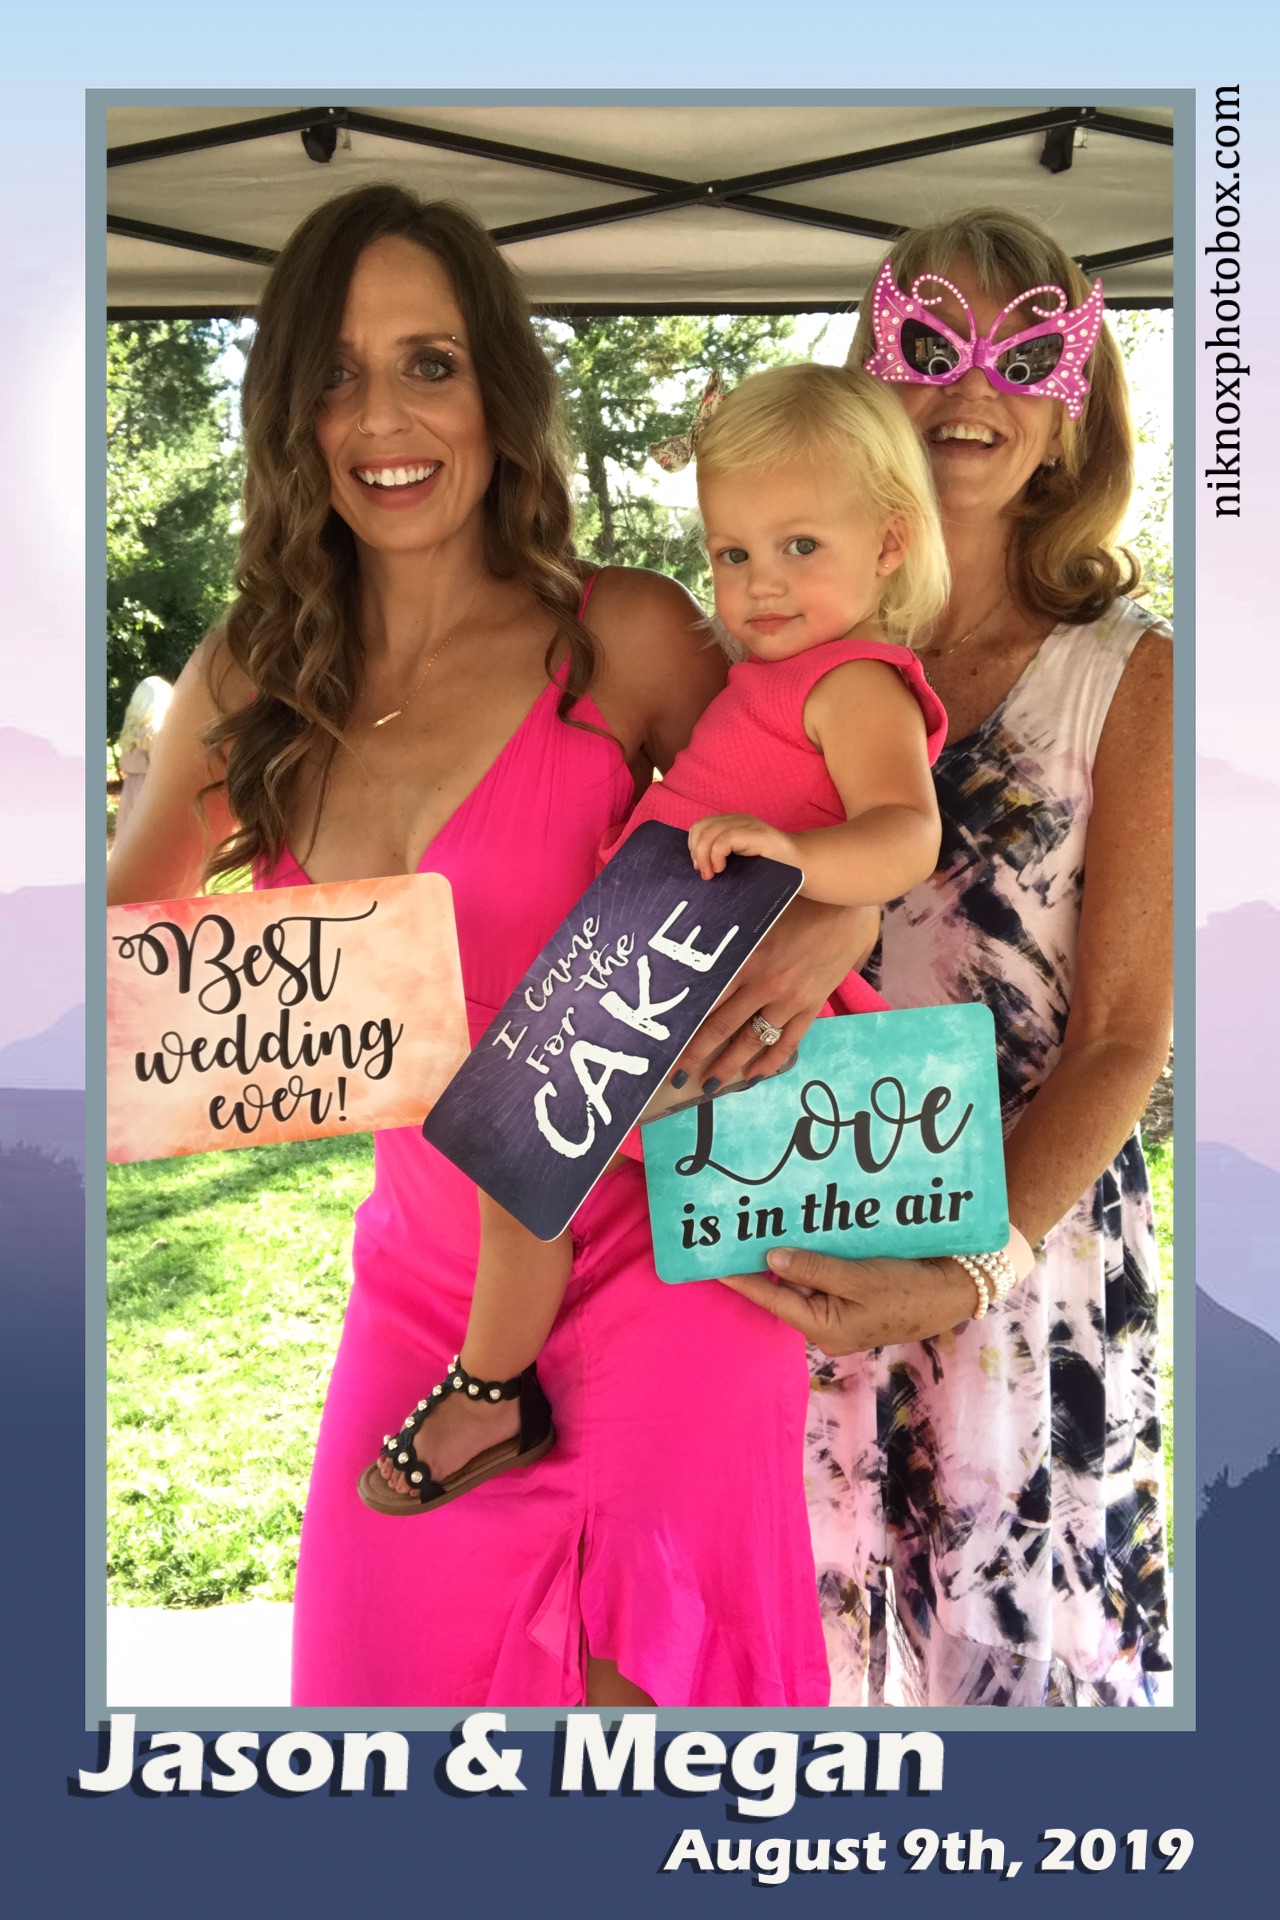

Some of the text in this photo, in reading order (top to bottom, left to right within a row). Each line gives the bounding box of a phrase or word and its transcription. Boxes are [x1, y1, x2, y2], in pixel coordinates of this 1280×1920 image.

[112, 901, 378, 1015] Best
[492, 914, 600, 1060] I came
[526, 931, 635, 1075] For the
[135, 1008, 404, 1084] wedding
[533, 900, 740, 1159] CAKE
[209, 1075, 347, 1134] ever!
[674, 1076, 975, 1186] Love
[681, 1176, 975, 1250] is in the air
